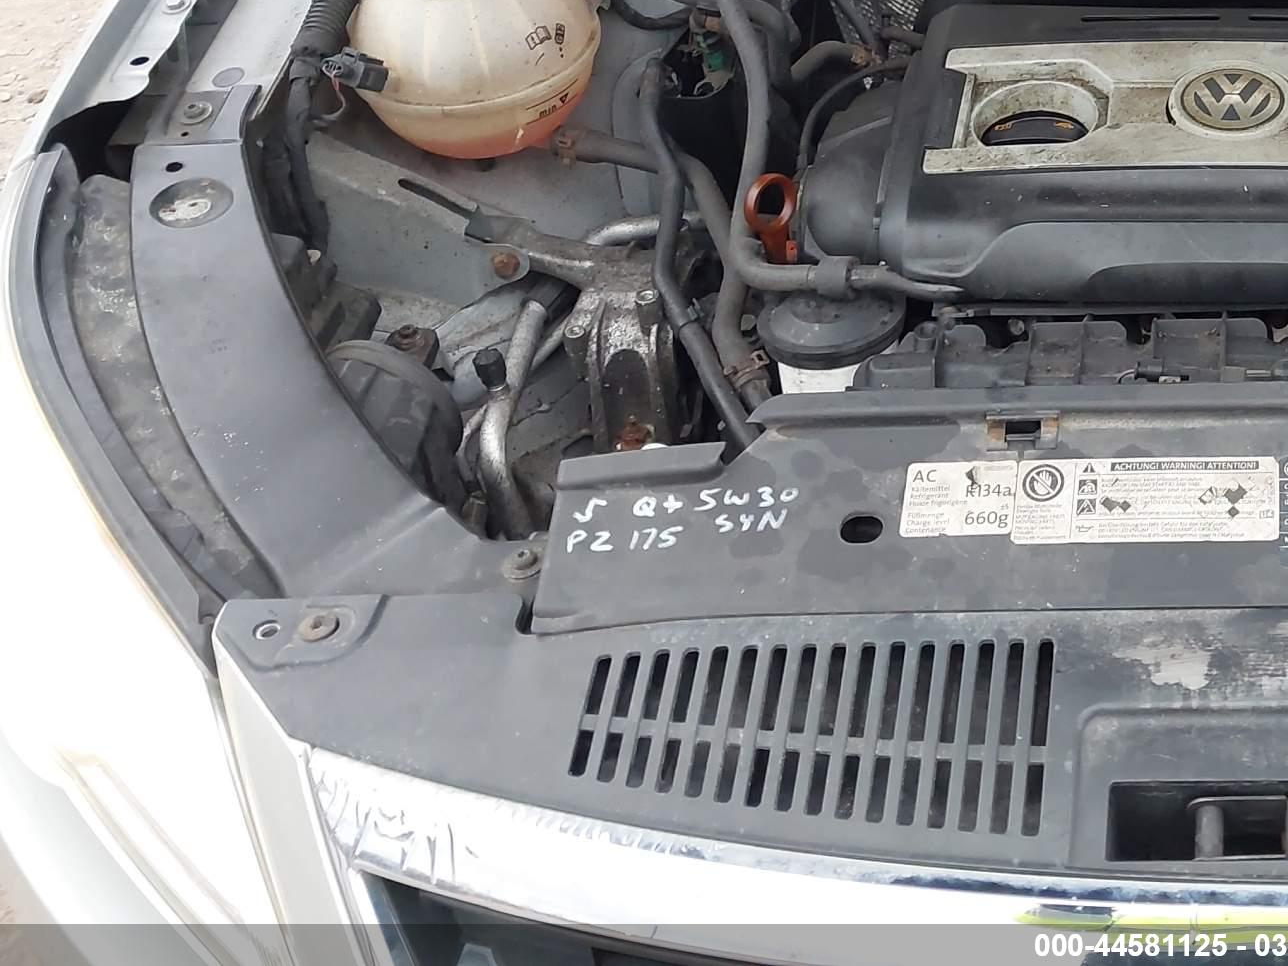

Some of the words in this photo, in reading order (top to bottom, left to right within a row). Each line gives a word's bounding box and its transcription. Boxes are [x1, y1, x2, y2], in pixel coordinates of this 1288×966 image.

[538, 104, 557, 118] min
[1113, 462, 1159, 471] ACHTUNG!
[1160, 461, 1205, 470] WARNING!
[1206, 461, 1257, 469] ATTENTION!
[912, 469, 937, 483] AC
[965, 483, 1012, 498] R134a
[715, 508, 788, 534] SYN
[964, 510, 1009, 529] 660g
